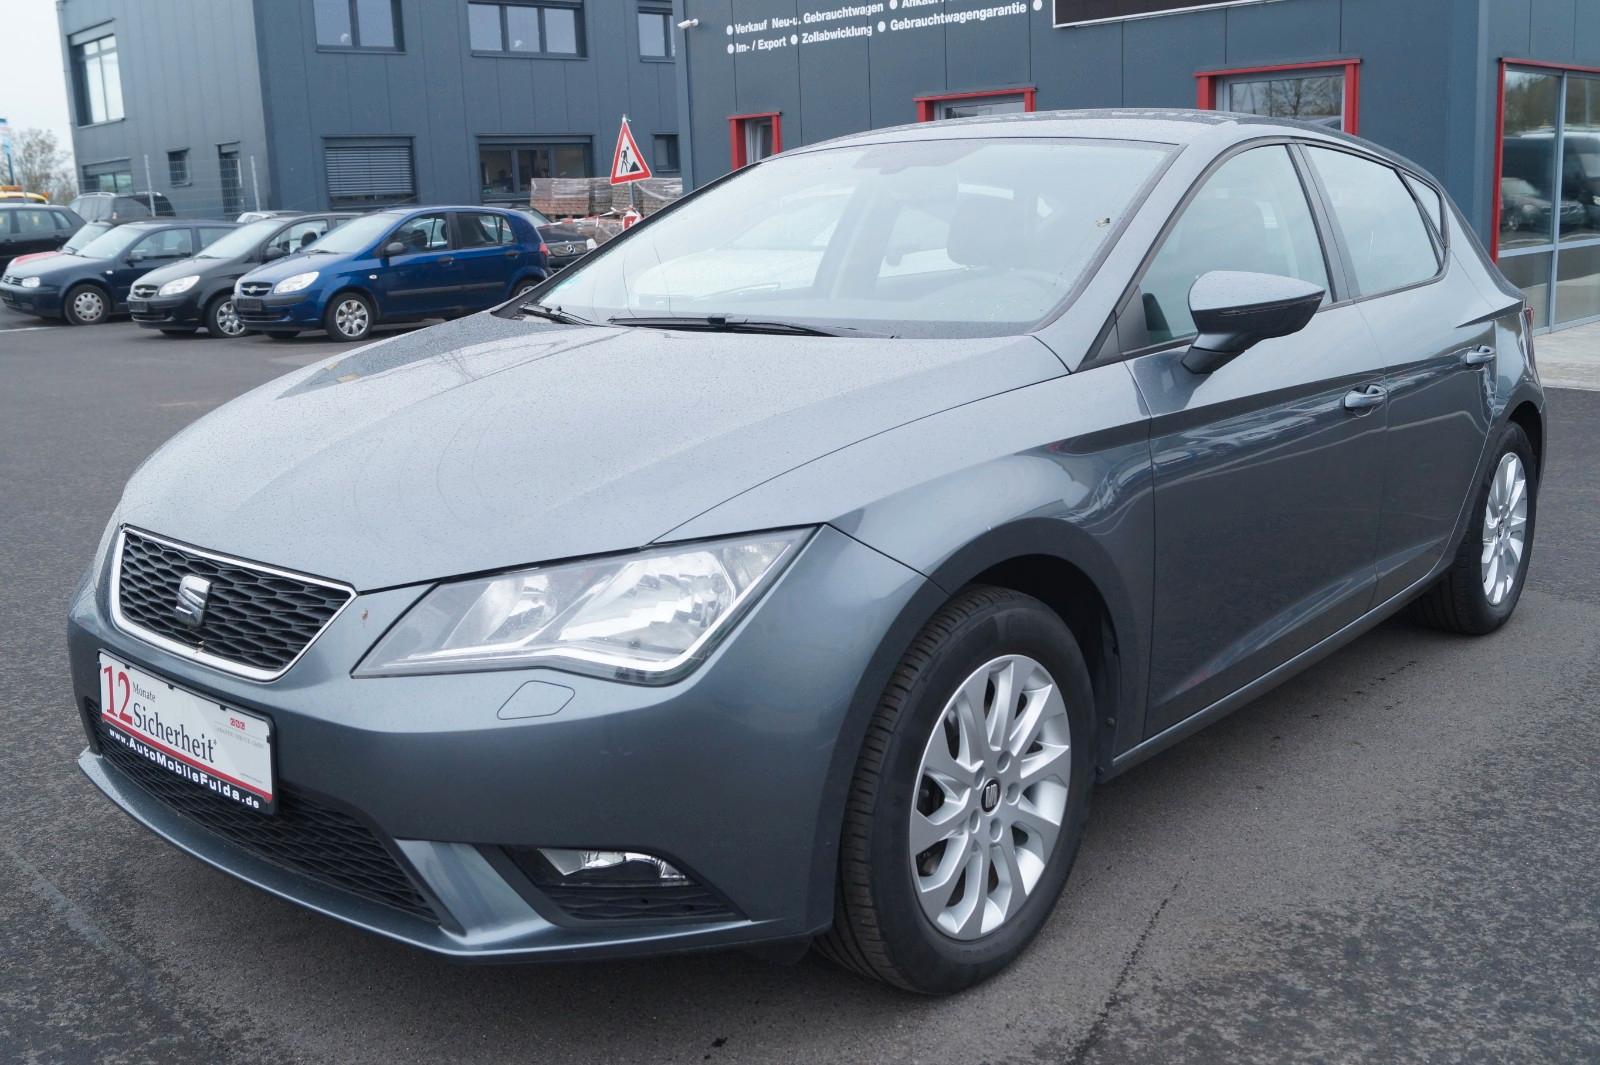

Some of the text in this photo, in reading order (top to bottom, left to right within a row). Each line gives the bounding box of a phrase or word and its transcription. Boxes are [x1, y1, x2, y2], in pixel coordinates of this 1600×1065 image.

[735, 20, 767, 34] Verkauf
[804, 2, 884, 24] Gebrauchtwagen
[901, 0, 938, 9] Ankau
[736, 42, 750, 53] Im-
[758, 37, 787, 51] Export
[802, 25, 873, 44] Zollabwicklung
[890, 2, 1027, 31] Gebrauchtwagengarantie
[103, 665, 133, 726] 12
[132, 681, 156, 703] Monate
[109, 728, 260, 809] www.AutoMobileFulda.de
